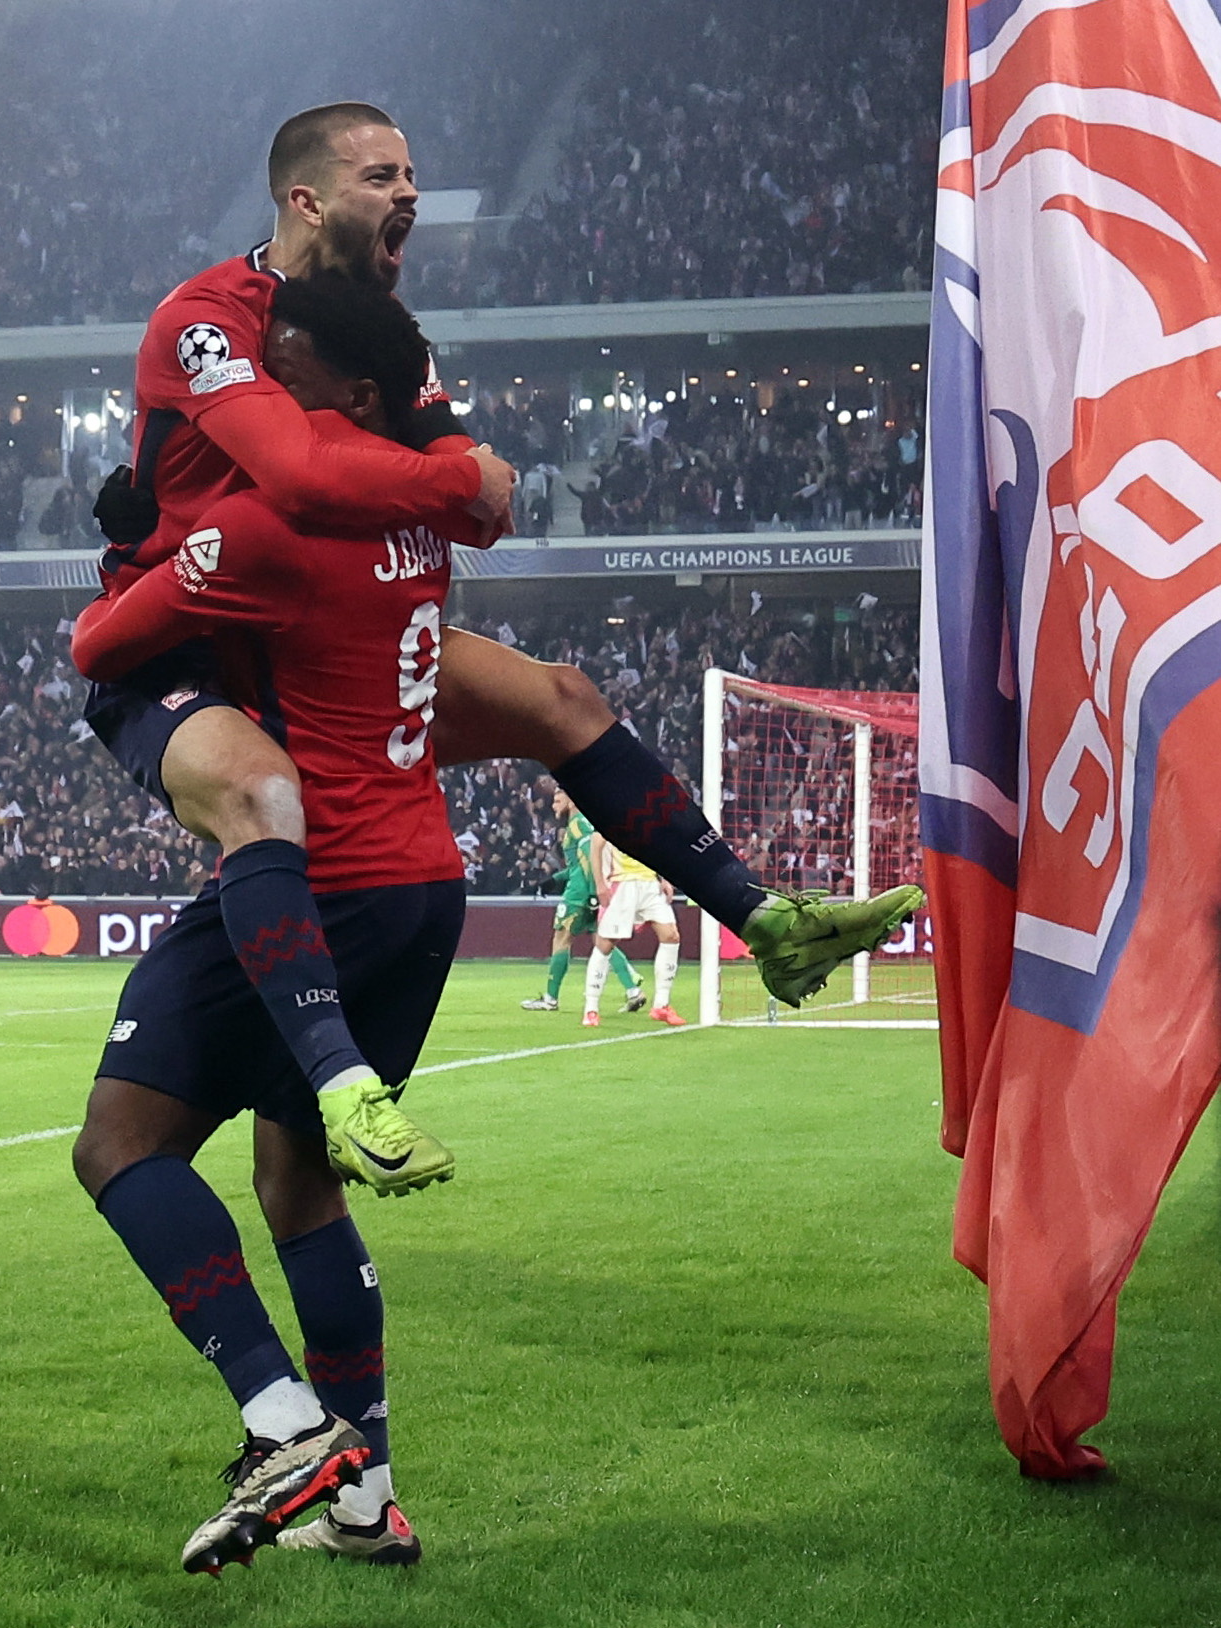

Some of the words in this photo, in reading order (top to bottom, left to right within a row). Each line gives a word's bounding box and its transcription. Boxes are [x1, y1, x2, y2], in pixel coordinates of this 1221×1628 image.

[604, 552, 655, 568] UEFA
[659, 549, 772, 567] CHAMPIONS
[779, 547, 854, 565] LEAGUE
[387, 600, 441, 770] 9
[690, 829, 720, 853] LOS
[295, 988, 340, 1008] LOSC
[203, 1335, 221, 1358] SC
